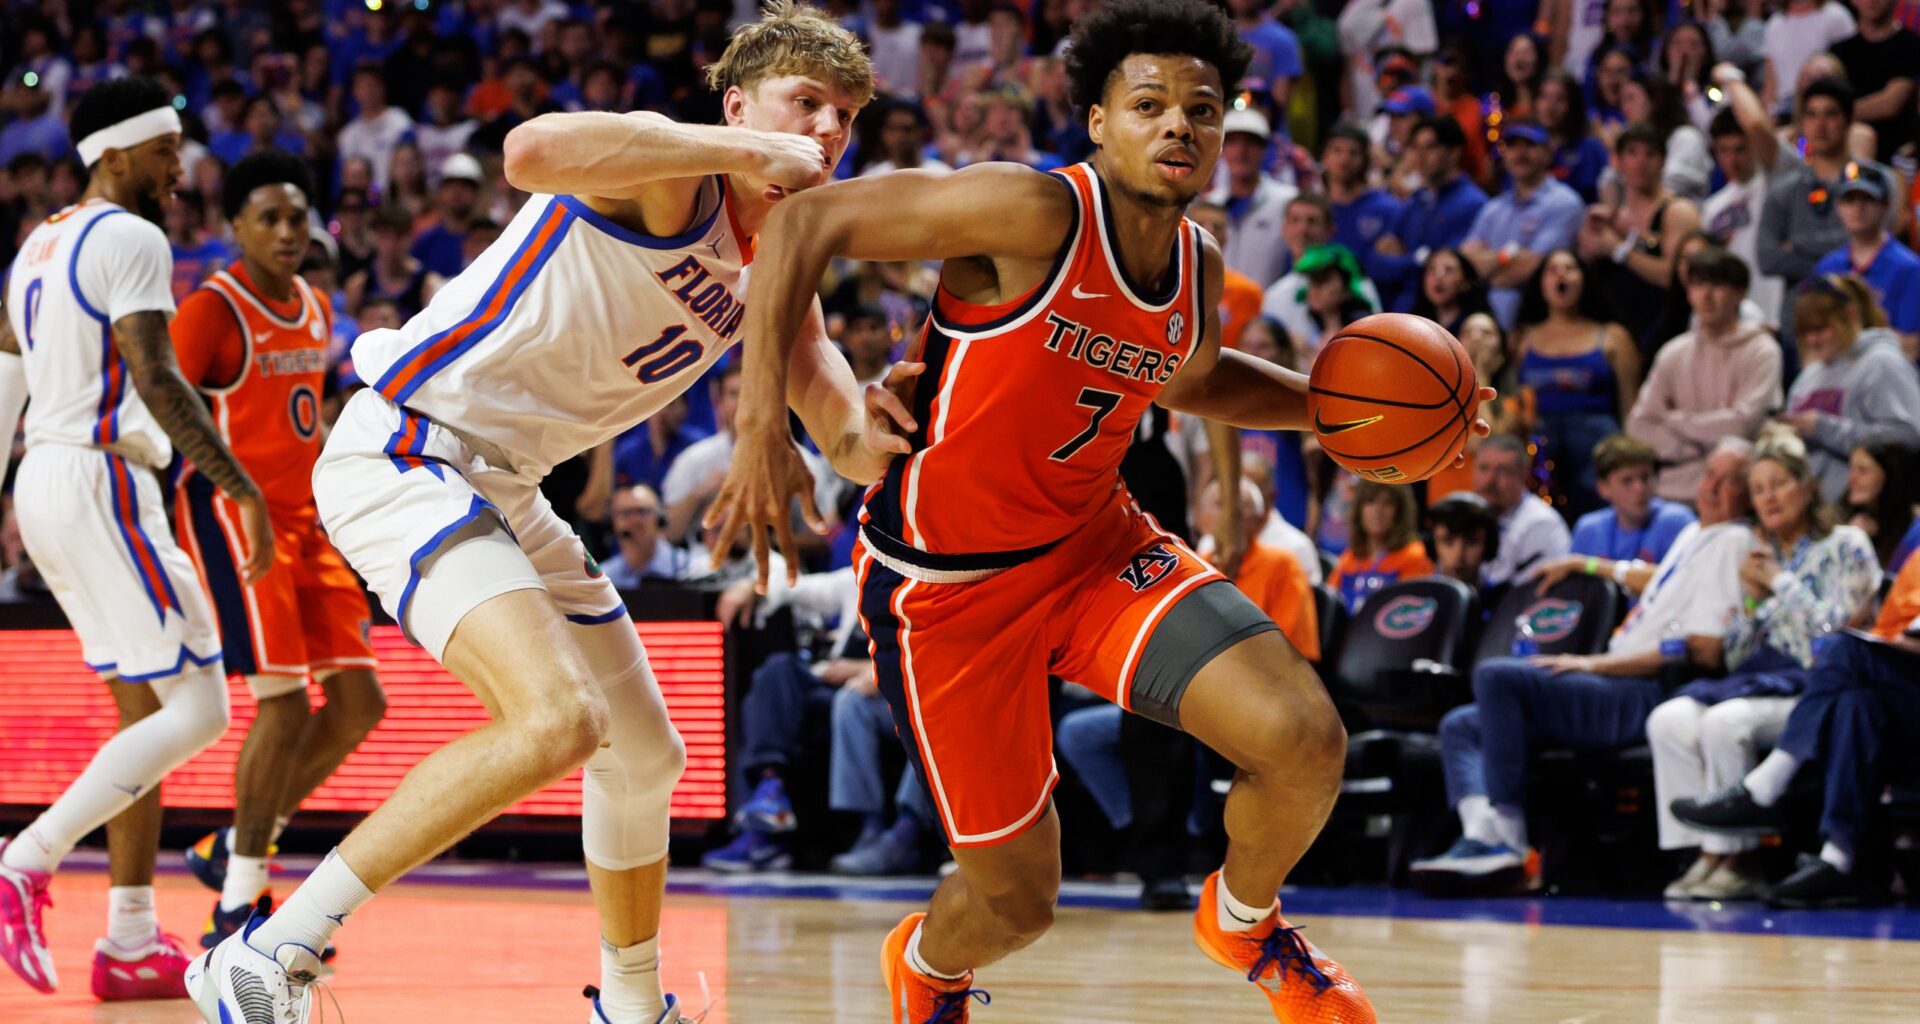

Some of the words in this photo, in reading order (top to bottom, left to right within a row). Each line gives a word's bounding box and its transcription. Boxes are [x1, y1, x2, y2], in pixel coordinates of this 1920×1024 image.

[621, 323, 705, 385] 10
[1043, 309, 1182, 385] TIGERS
[1168, 312, 1185, 344] SEC
[288, 383, 320, 443] 0
[1047, 386, 1125, 463] 7
